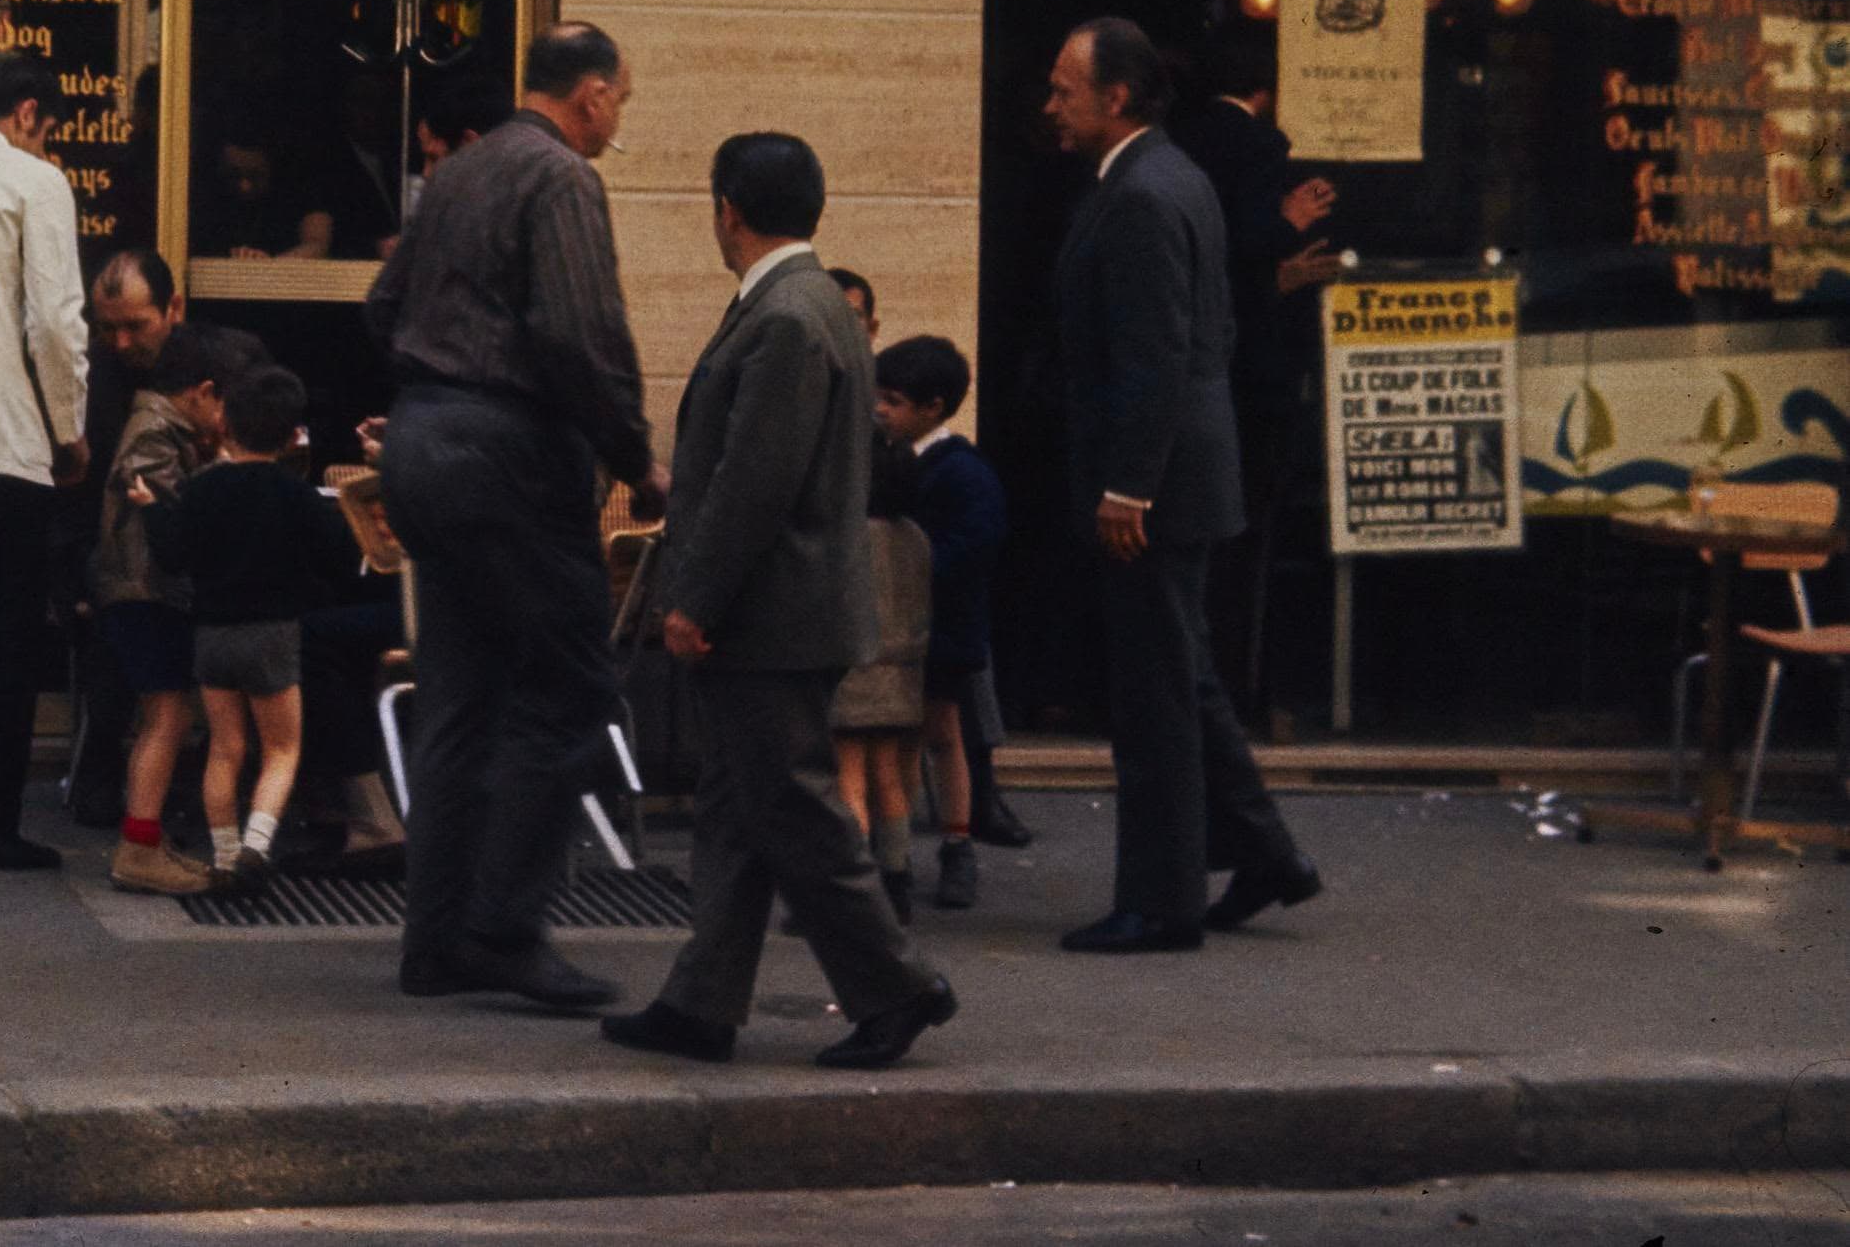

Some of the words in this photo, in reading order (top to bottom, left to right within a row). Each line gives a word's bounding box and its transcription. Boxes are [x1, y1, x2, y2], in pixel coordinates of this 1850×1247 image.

[1356, 288, 1491, 311] France
[1333, 308, 1512, 333] Dimanche
[1426, 394, 1504, 415] MACIAS
